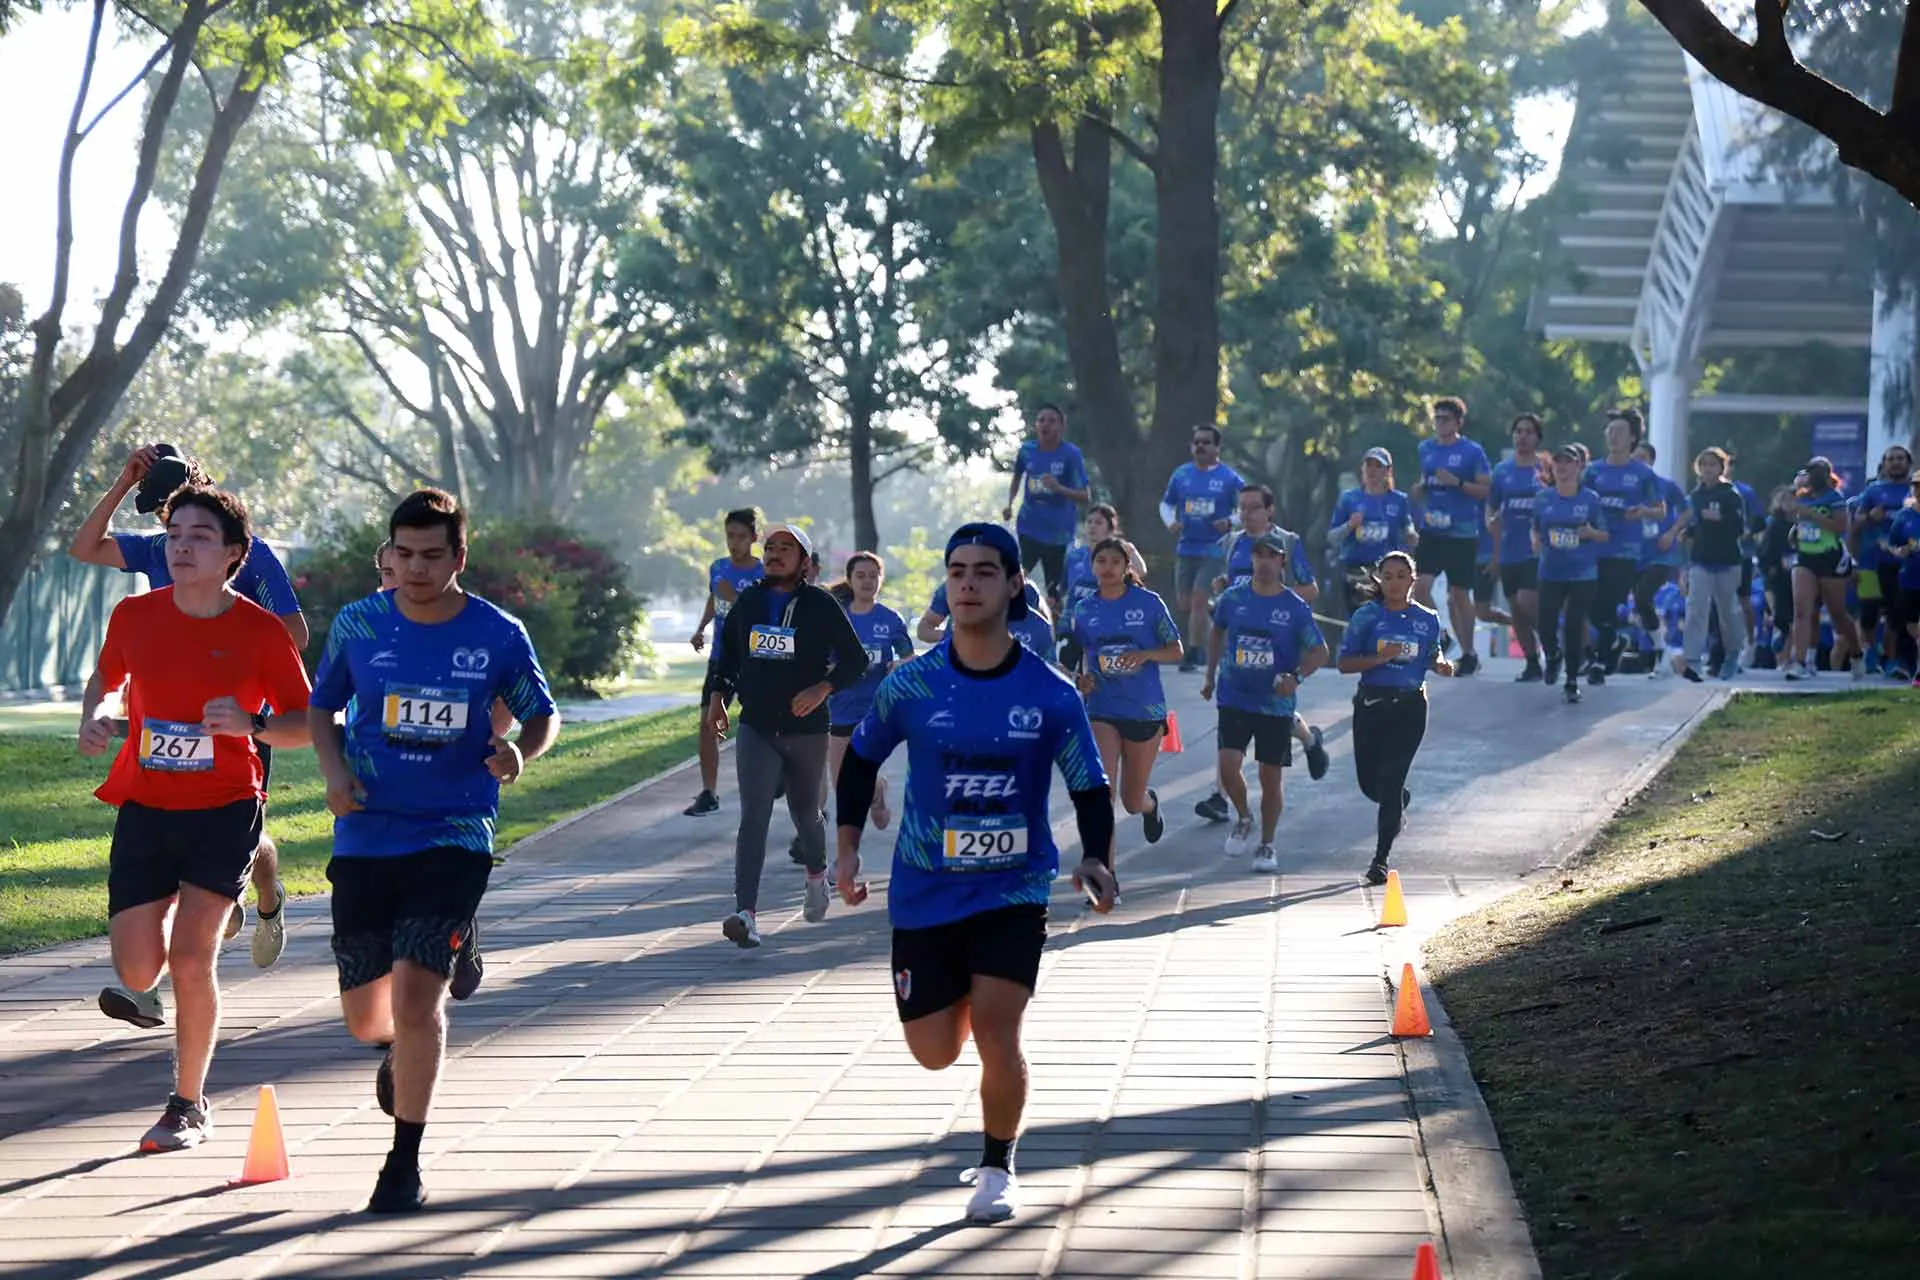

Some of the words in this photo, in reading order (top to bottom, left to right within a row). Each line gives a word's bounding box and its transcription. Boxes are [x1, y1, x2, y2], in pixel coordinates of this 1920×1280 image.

[757, 634, 786, 650] 205
[400, 699, 454, 728] 114
[151, 734, 201, 759] 267
[944, 774, 1020, 798] FEEL
[959, 831, 1015, 857] 290
